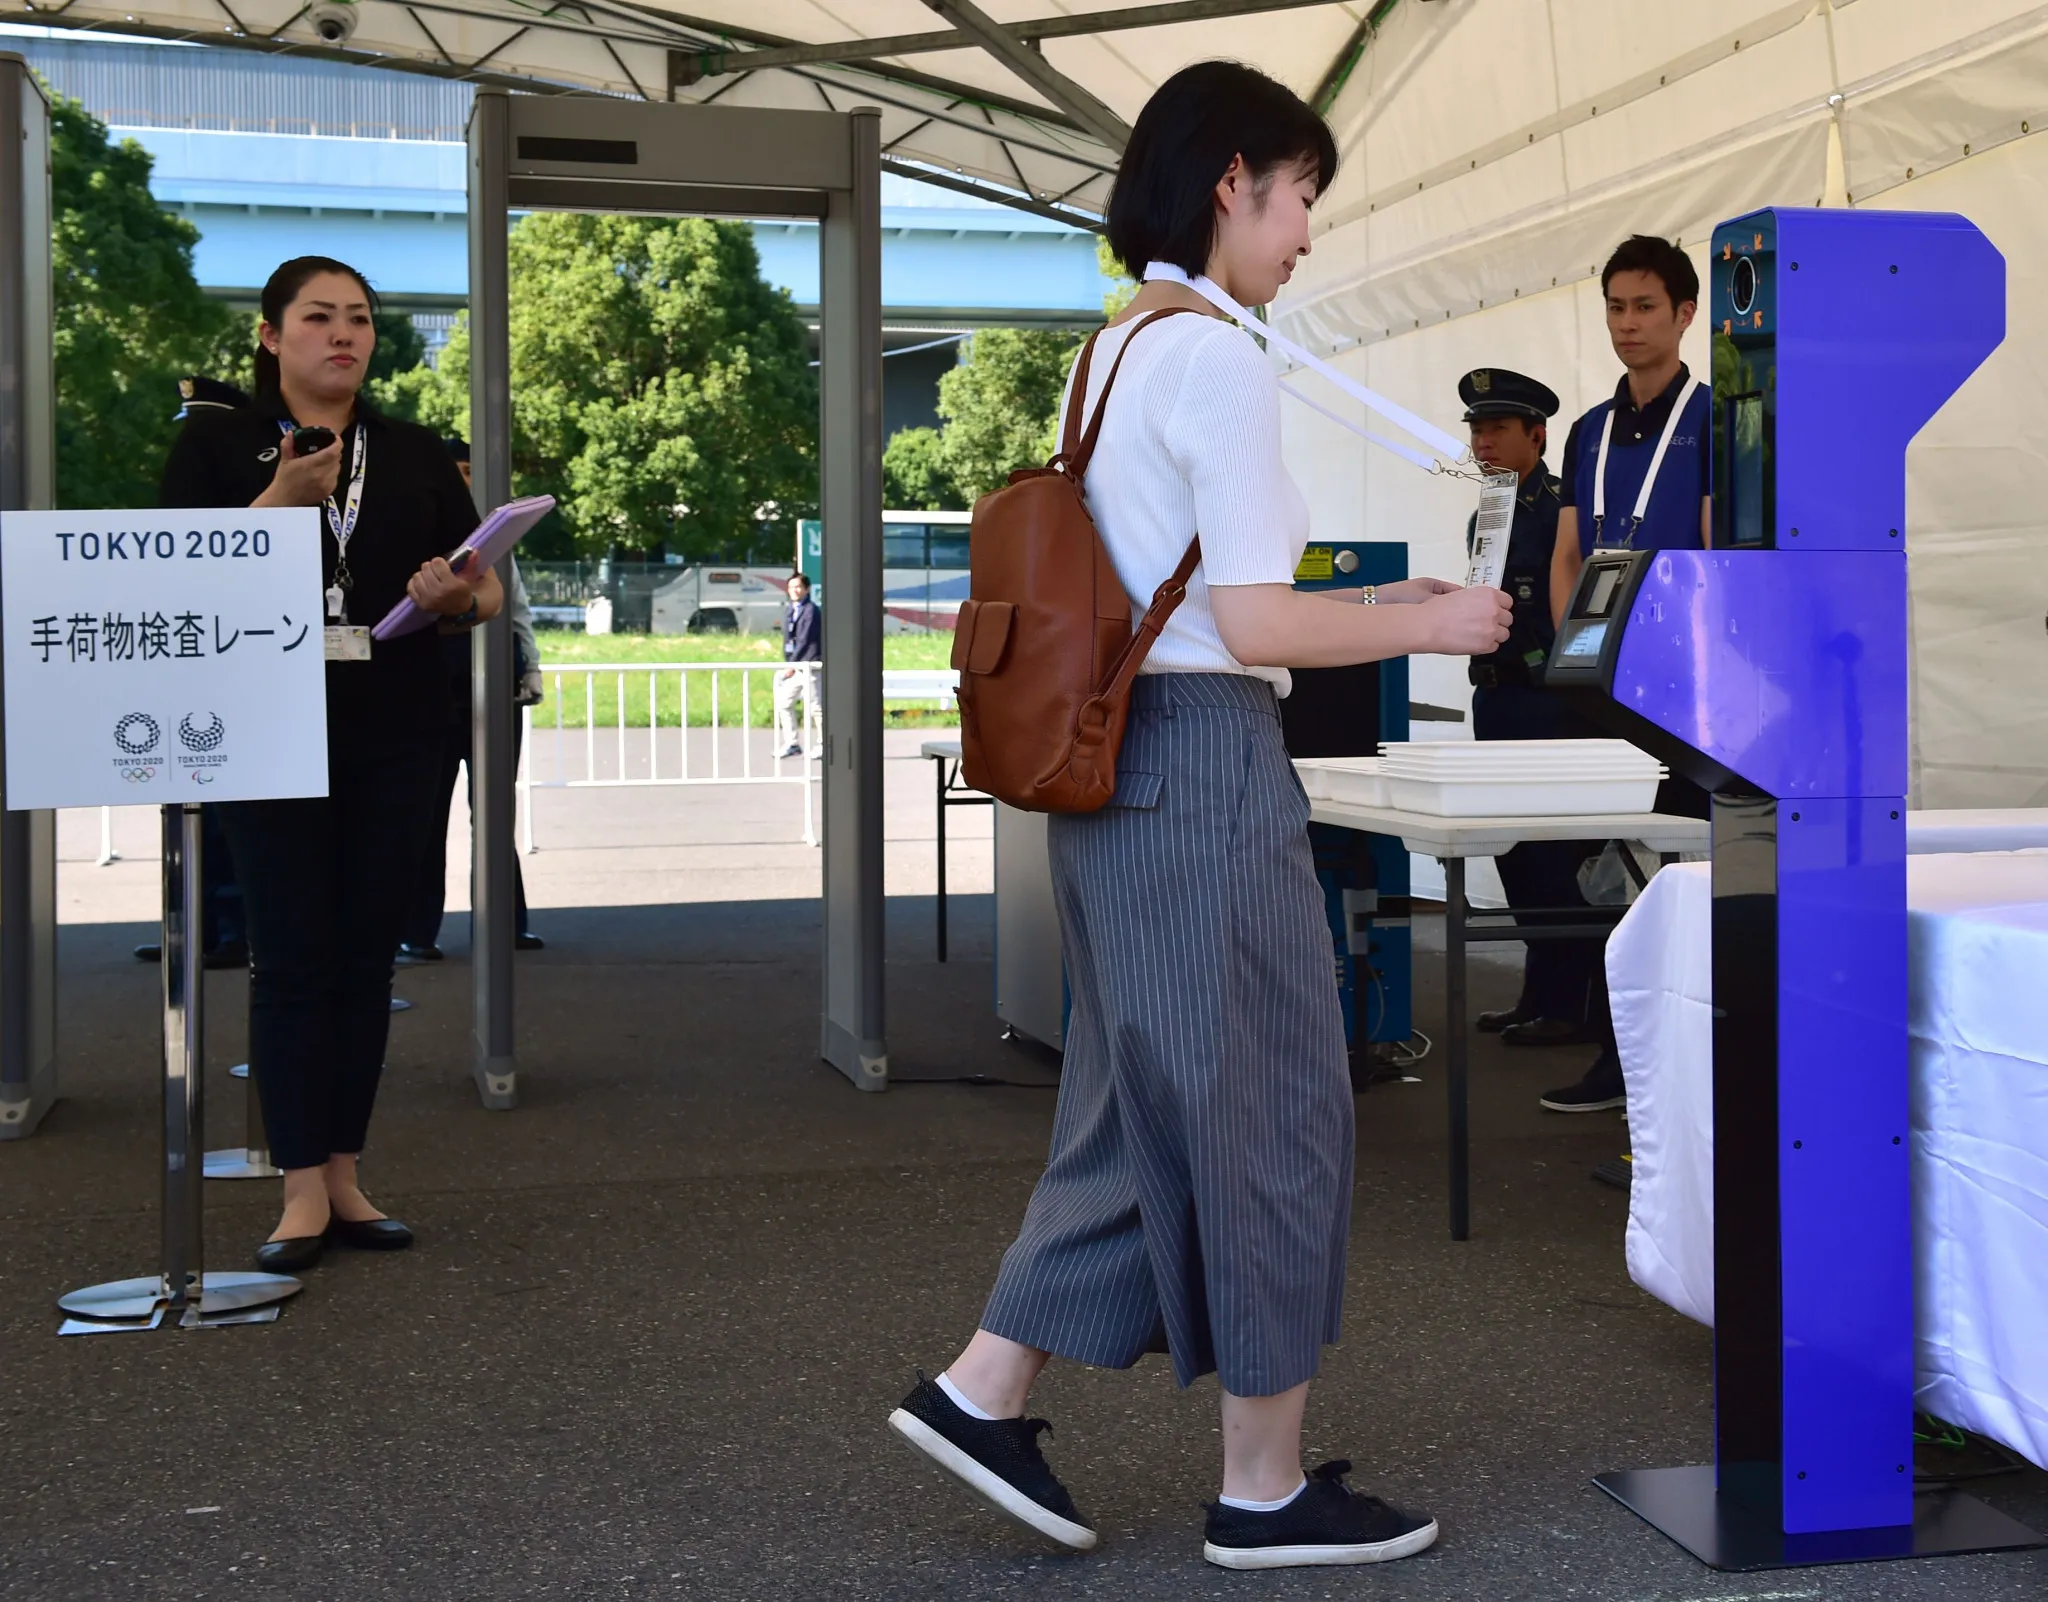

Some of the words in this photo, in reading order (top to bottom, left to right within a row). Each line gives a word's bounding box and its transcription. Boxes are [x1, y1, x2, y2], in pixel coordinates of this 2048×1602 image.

[328, 507, 342, 539] ALSO
[343, 507, 356, 540] ALSO
[55, 531, 175, 561] TOKYO
[185, 529, 270, 559] 2020
[30, 611, 309, 663] 手荷物検査レーン
[113, 758, 142, 767] TOKYO
[143, 757, 164, 765] 2020
[178, 756, 206, 764] TOKYO
[207, 755, 228, 763] 2020
